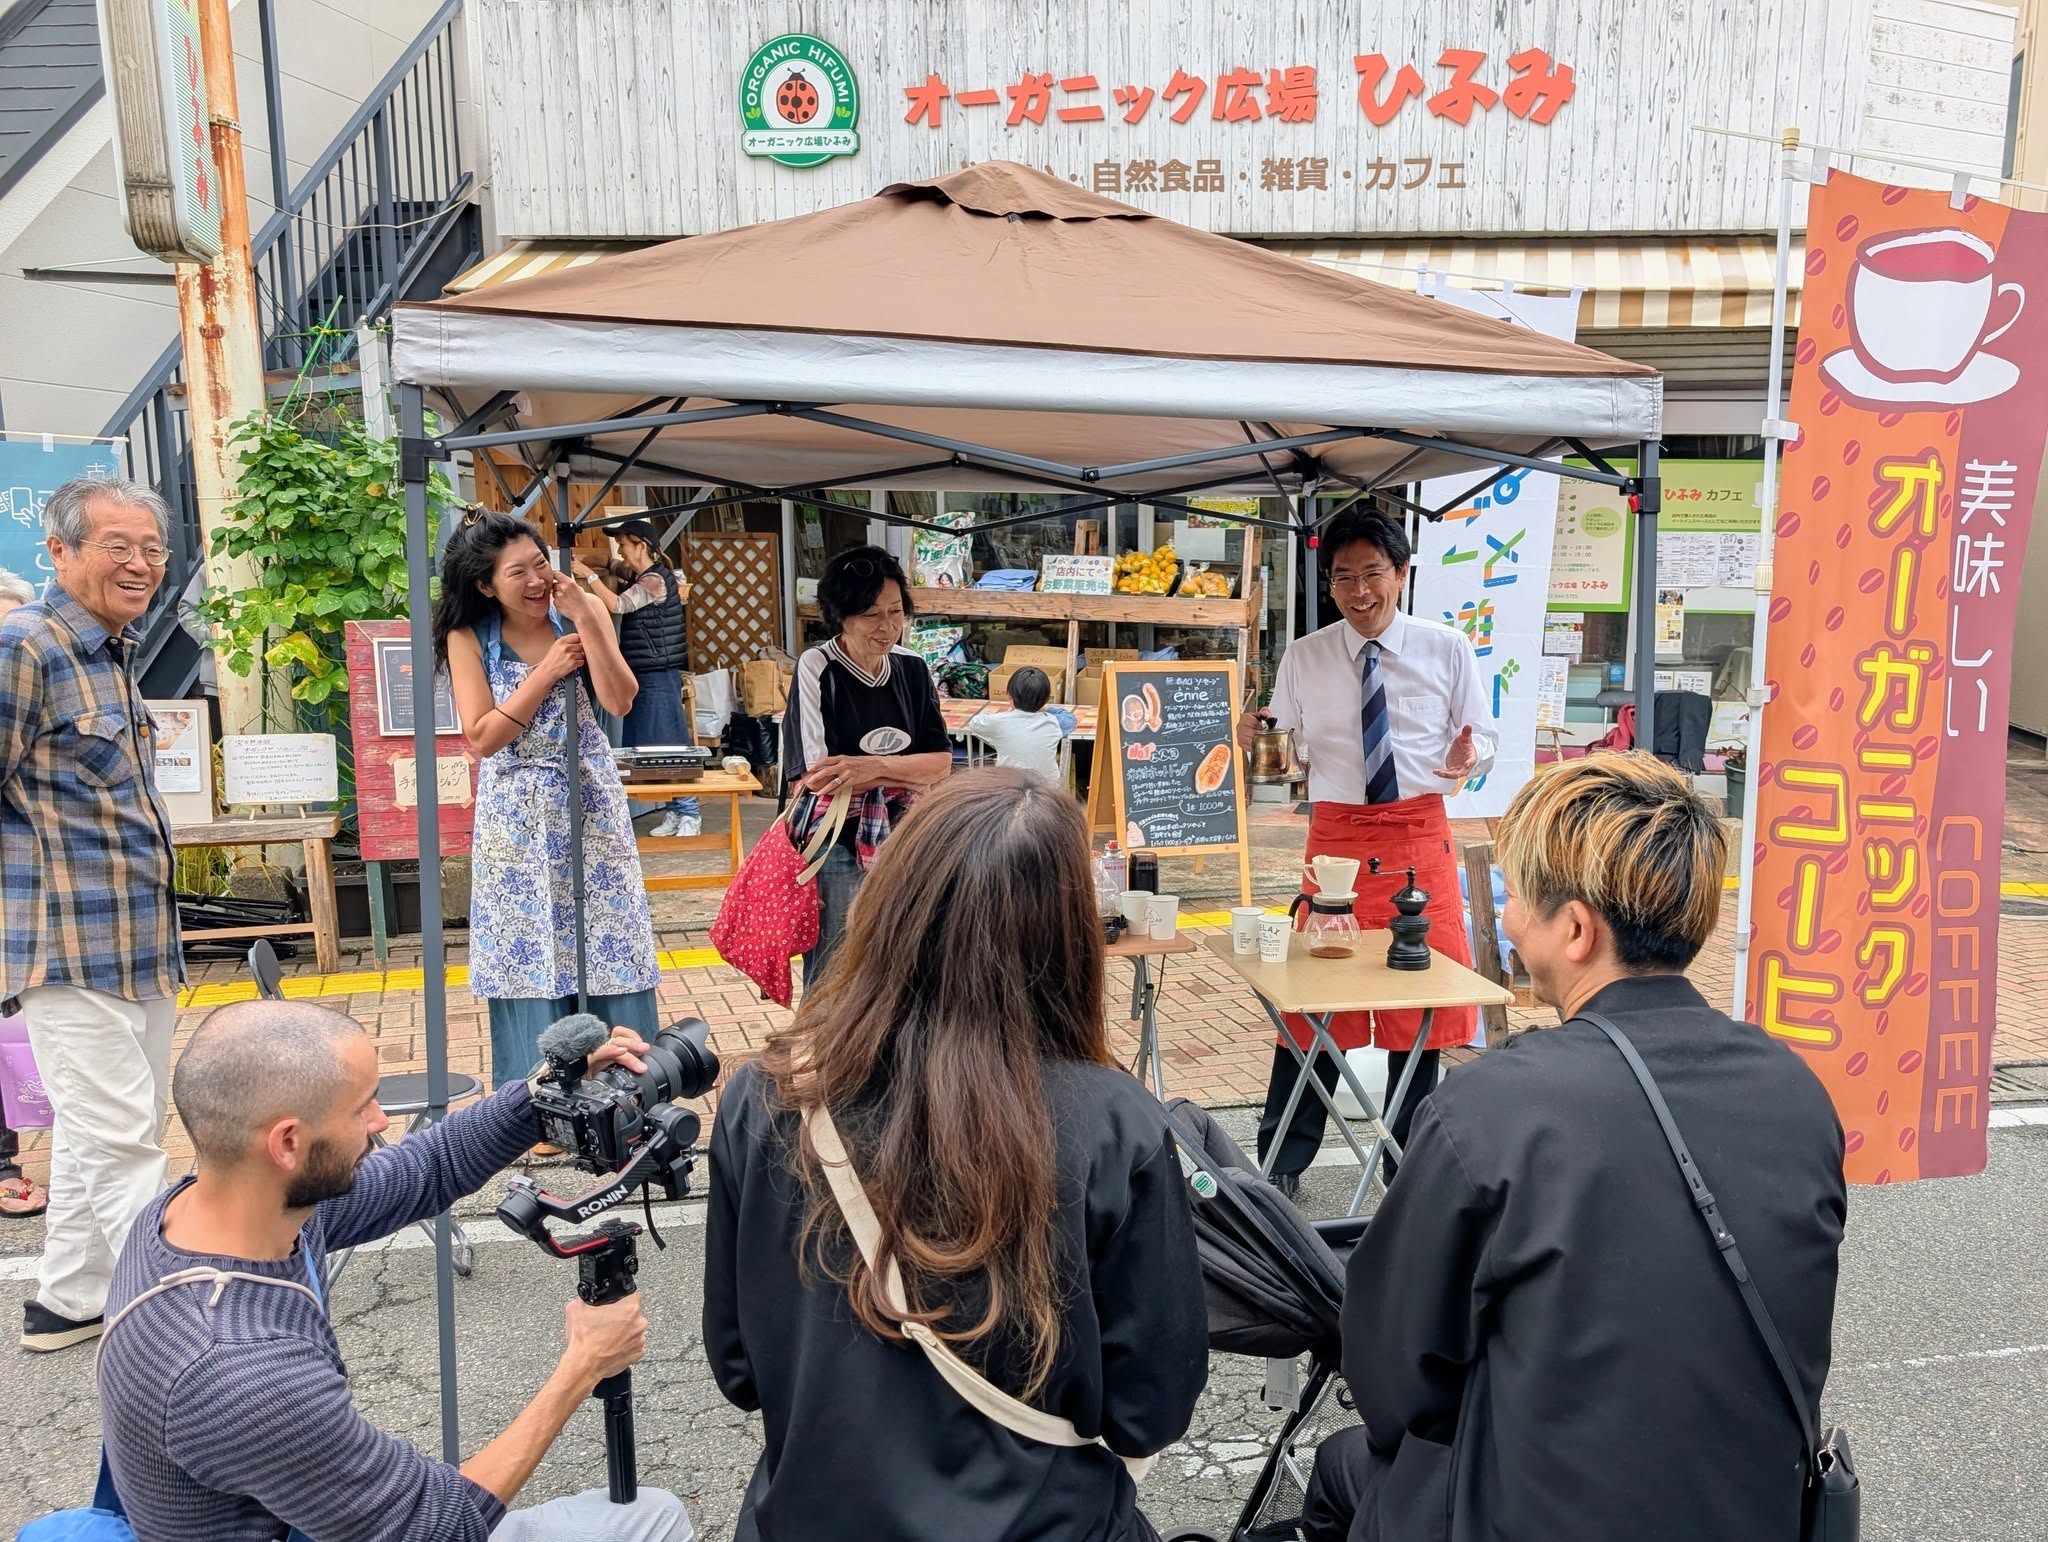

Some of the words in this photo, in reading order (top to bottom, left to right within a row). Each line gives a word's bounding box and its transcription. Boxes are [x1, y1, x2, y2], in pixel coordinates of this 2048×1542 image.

[746, 41, 801, 107] ORGANIC
[807, 44, 850, 103] HIFUMI
[903, 65, 1319, 128] オーガニック広場
[1353, 47, 1578, 127] ひふみ
[747, 135, 852, 148] オーガニック広場ひふみ
[1068, 157, 1466, 194] ・自然食品・雑貨・カフェ
[1664, 488, 1702, 501] ひふみ
[1705, 489, 1743, 501] カフェ
[1043, 579, 1109, 593] お野菜販売中
[1055, 566, 1096, 577] 店内にて
[1581, 580, 1609, 590] ひふみ
[1946, 458, 2018, 738] 美味しい
[1173, 691, 1210, 703] enne
[1856, 452, 1945, 1005] オーガニック
[1763, 765, 1849, 1045] コーヒ
[1259, 923, 1281, 936] ELAX
[1933, 814, 1982, 1134] COFFEE
[577, 1184, 629, 1218] RONIN
